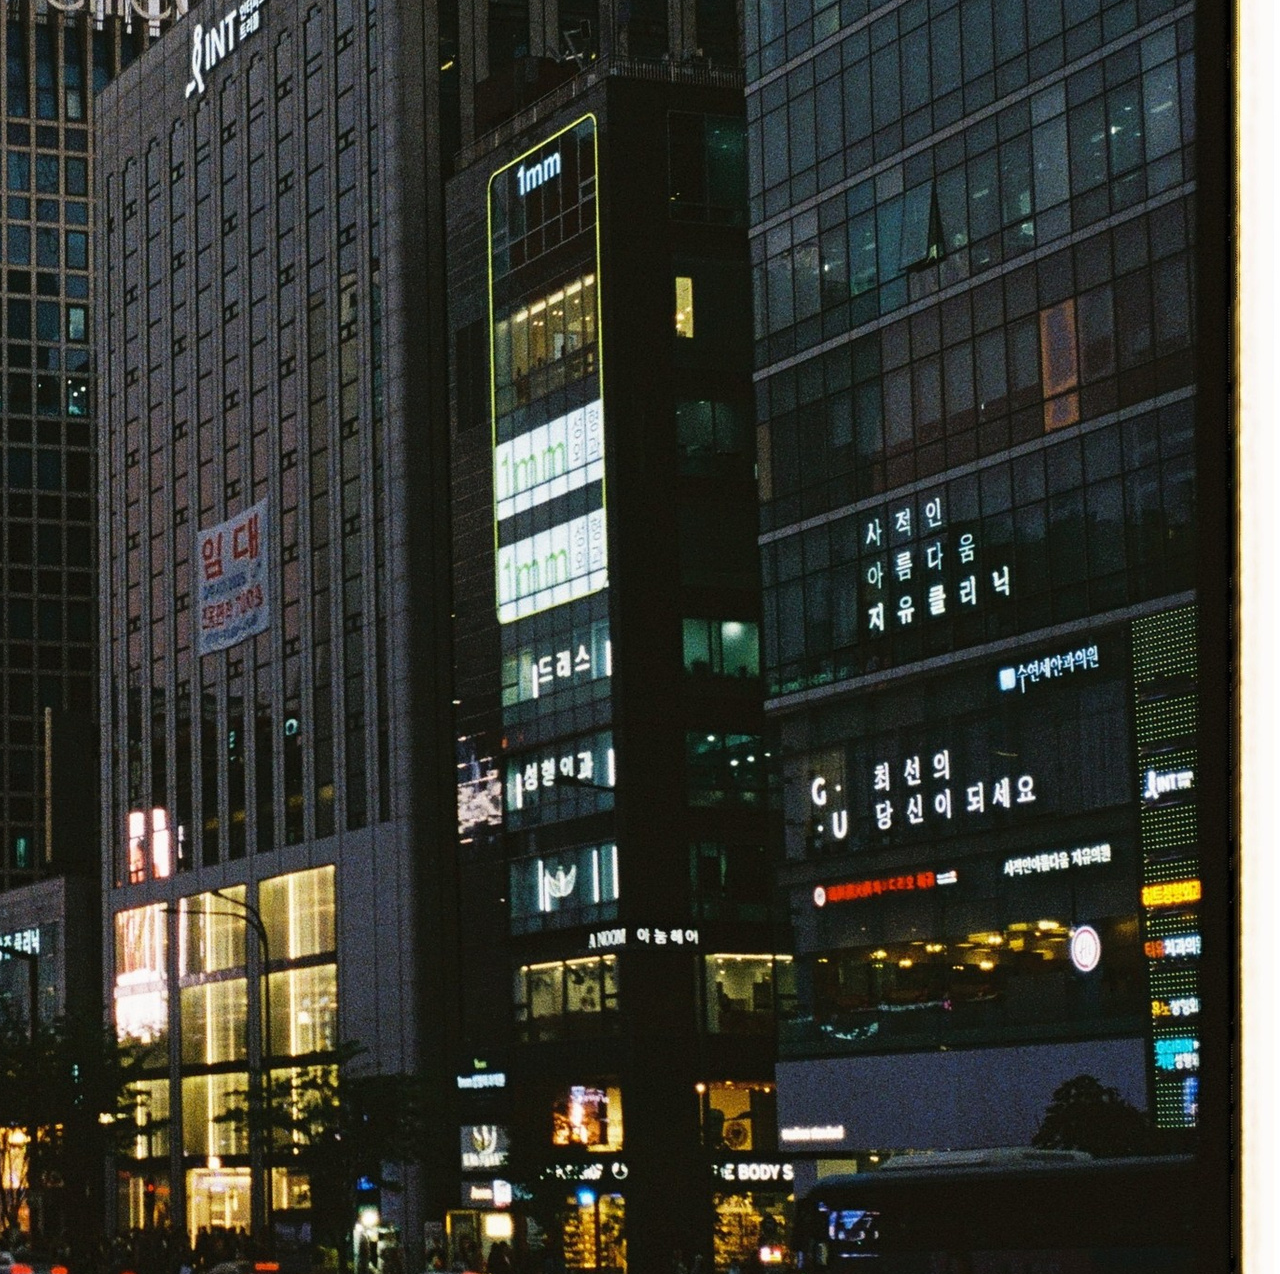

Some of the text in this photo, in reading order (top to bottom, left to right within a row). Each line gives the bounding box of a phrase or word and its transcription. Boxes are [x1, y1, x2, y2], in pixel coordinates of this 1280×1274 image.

[204, 8, 239, 72] INT
[516, 152, 562, 196] 1mm
[202, 513, 260, 579] 임대
[866, 497, 942, 547] 사적인
[866, 533, 976, 590] 아름다움
[868, 564, 1010, 631] 지유클리닉
[537, 645, 592, 684] 드레스
[1016, 645, 1099, 693] 수연세안과의원
[874, 750, 951, 792] 최선의
[875, 775, 1036, 830] 당신이 되세요
[737, 1163, 780, 1181] BODY
